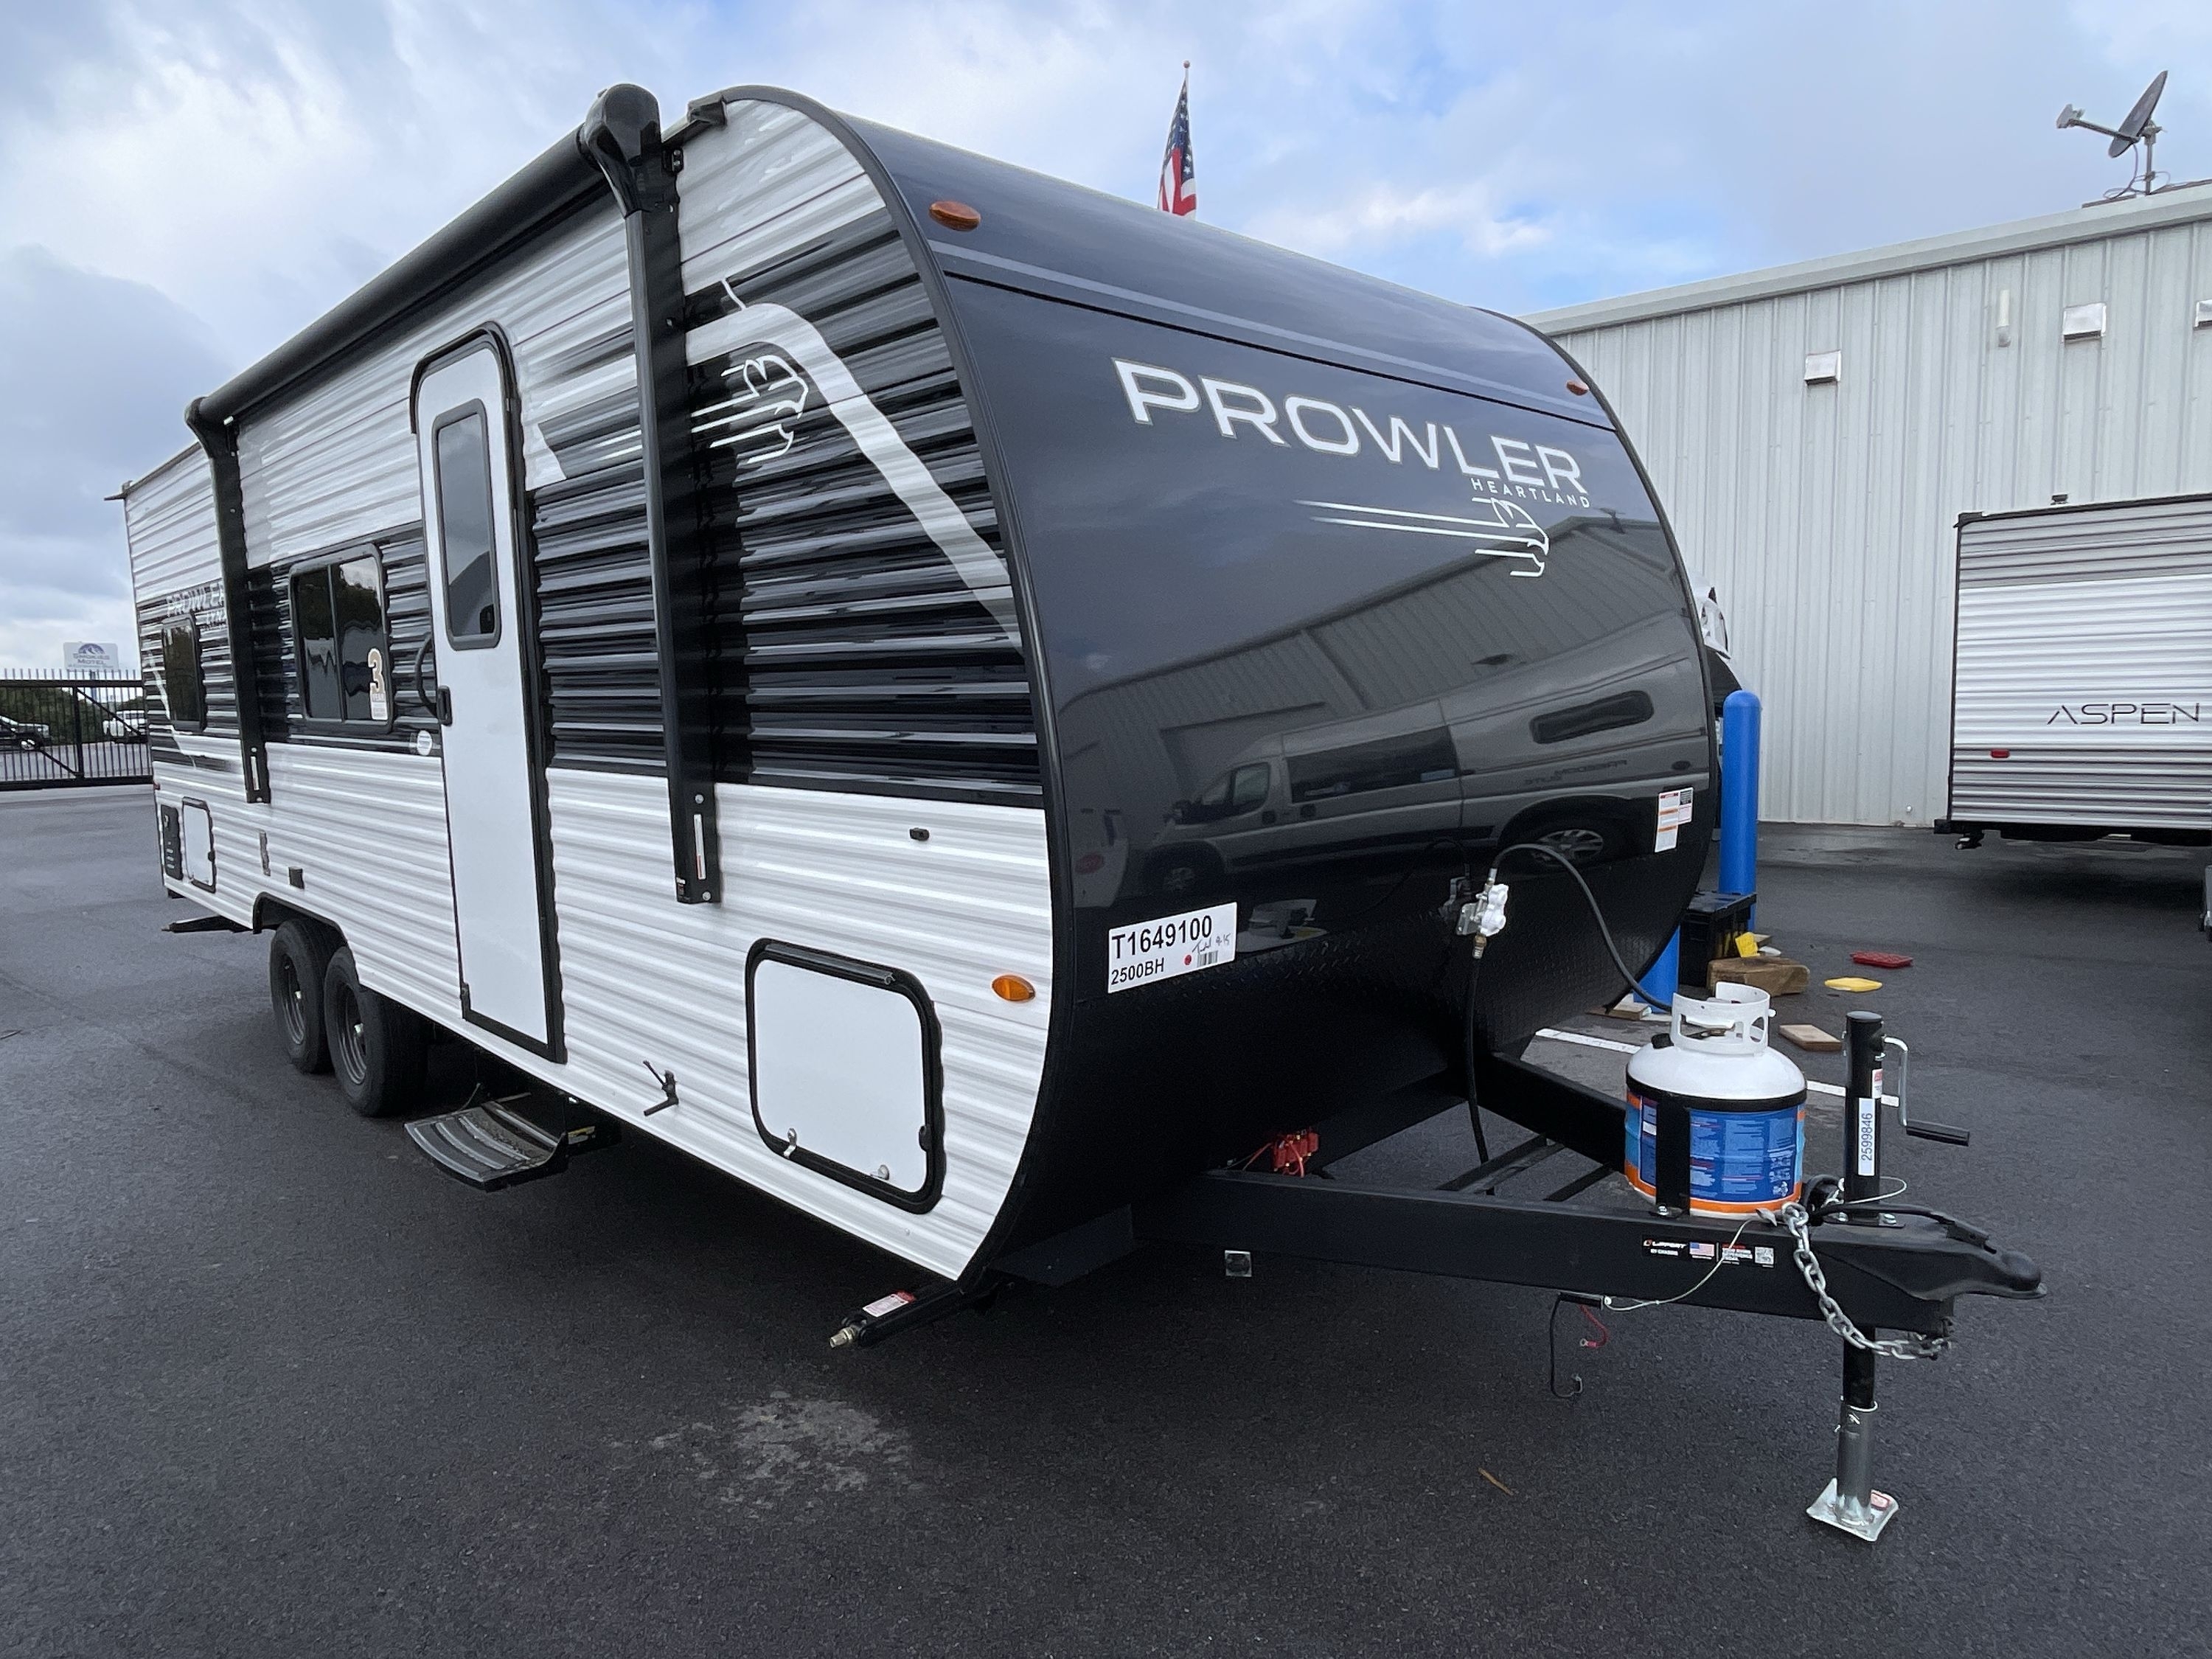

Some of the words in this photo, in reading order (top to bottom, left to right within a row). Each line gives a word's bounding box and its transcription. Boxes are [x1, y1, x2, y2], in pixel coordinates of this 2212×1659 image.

[1112, 358, 1588, 494] PROWLER
[1470, 477, 1590, 509] HEARTLAND
[368, 648, 385, 693] 3
[2047, 702, 2199, 725] ASPEN
[1112, 915, 1212, 959] T1649100
[1111, 957, 1164, 984] 2500BH
[1861, 1113, 1873, 1161] 2599846
